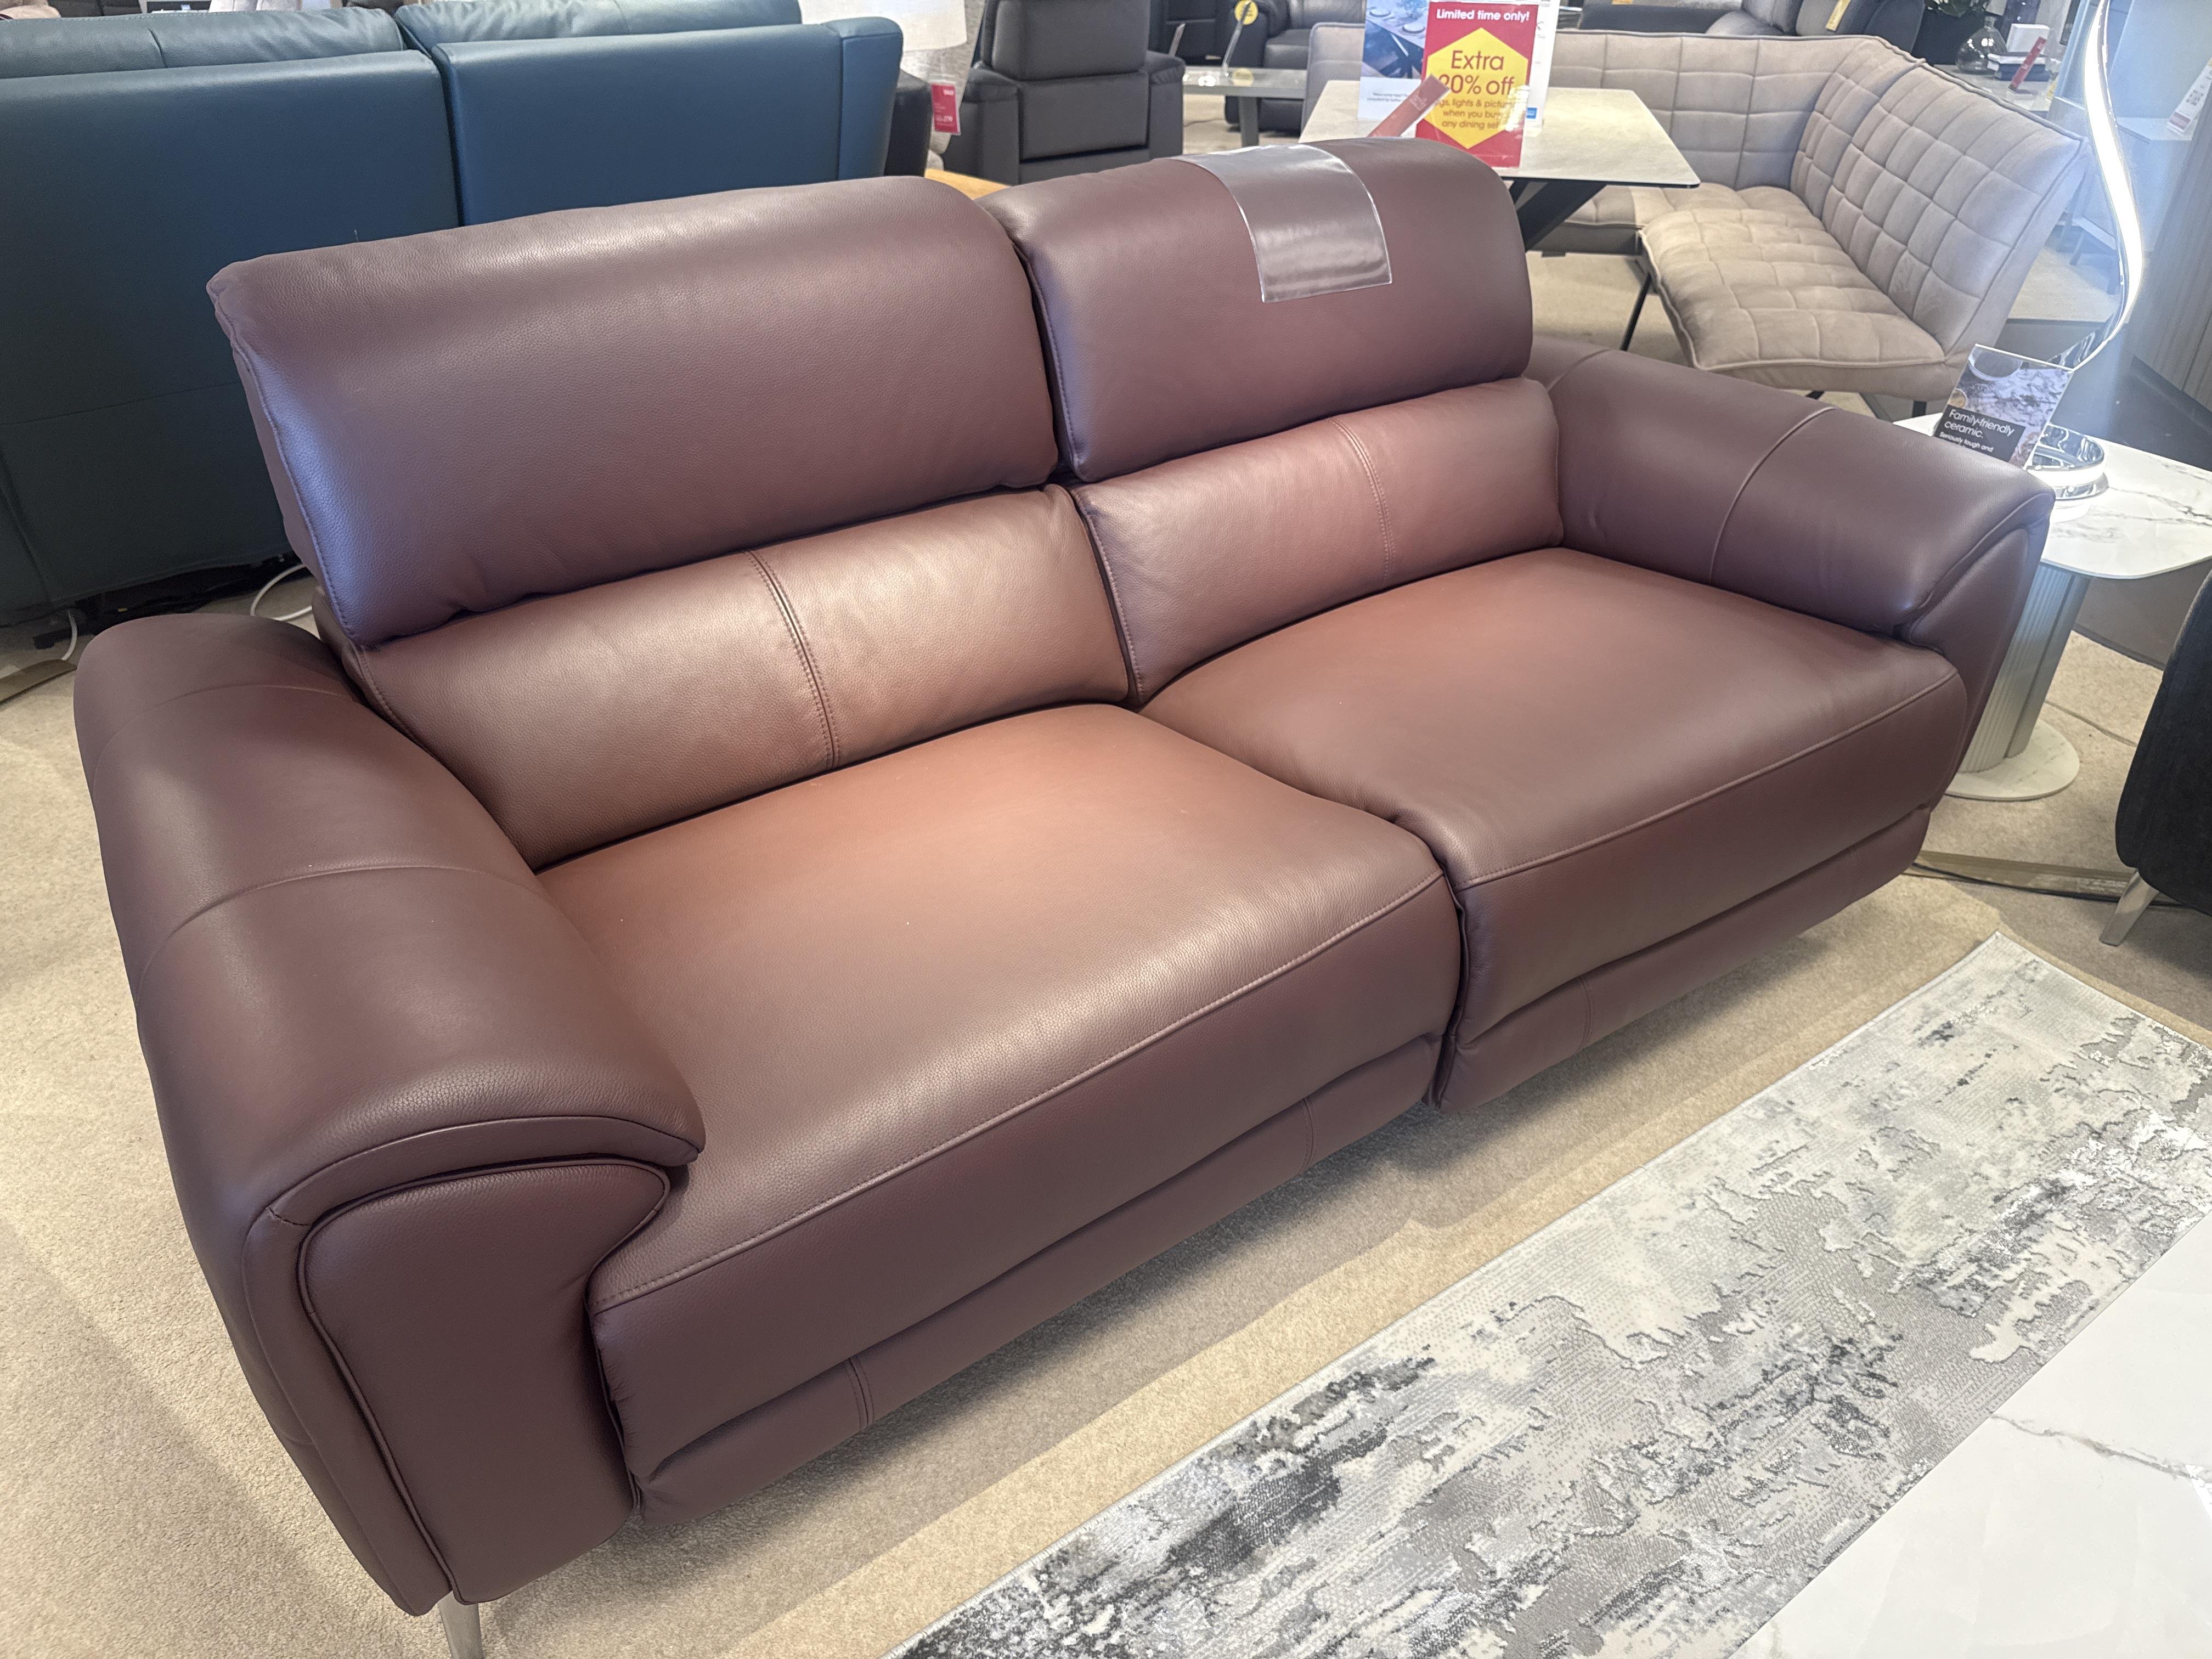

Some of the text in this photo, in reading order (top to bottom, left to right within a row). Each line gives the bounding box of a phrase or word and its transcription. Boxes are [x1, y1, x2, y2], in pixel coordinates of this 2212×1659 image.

[1437, 9, 1530, 22] Limited time only!
[1451, 50, 1504, 70] Extra
[1486, 76, 1515, 95] off
[1453, 99, 1473, 108] lights
[1443, 109, 1466, 117] when
[1459, 121, 1485, 129] dining
[1944, 421, 1984, 438] ceramic.
[1949, 409, 2015, 437] Family-friendly
[1939, 431, 1963, 444] Seriously
[1963, 438, 1981, 449] tough
